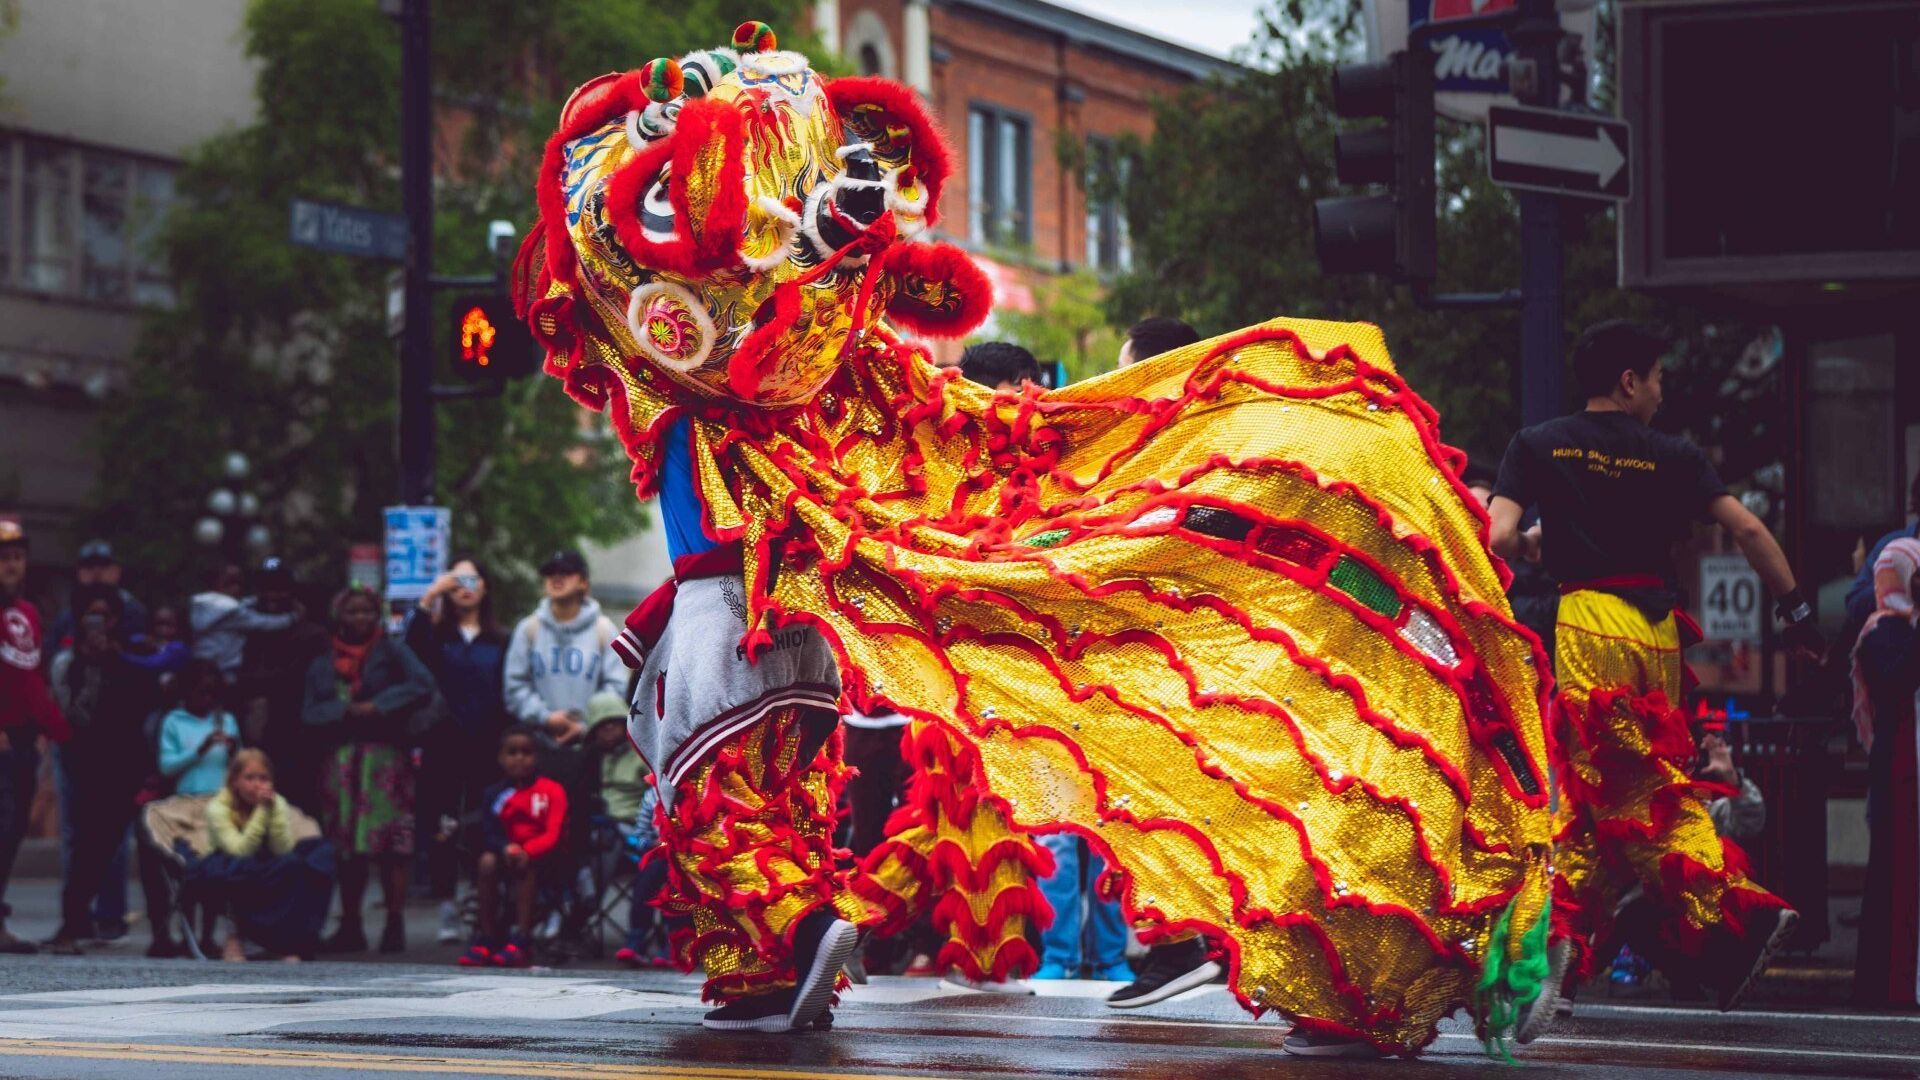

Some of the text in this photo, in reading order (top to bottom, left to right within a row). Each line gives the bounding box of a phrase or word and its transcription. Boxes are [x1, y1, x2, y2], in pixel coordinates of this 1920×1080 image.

[1431, 35, 1515, 80] Ma
[323, 206, 371, 248] Yates
[1552, 448, 1583, 458] HUNG
[1615, 458, 1656, 471] KWOON
[1707, 579, 1756, 616] 40
